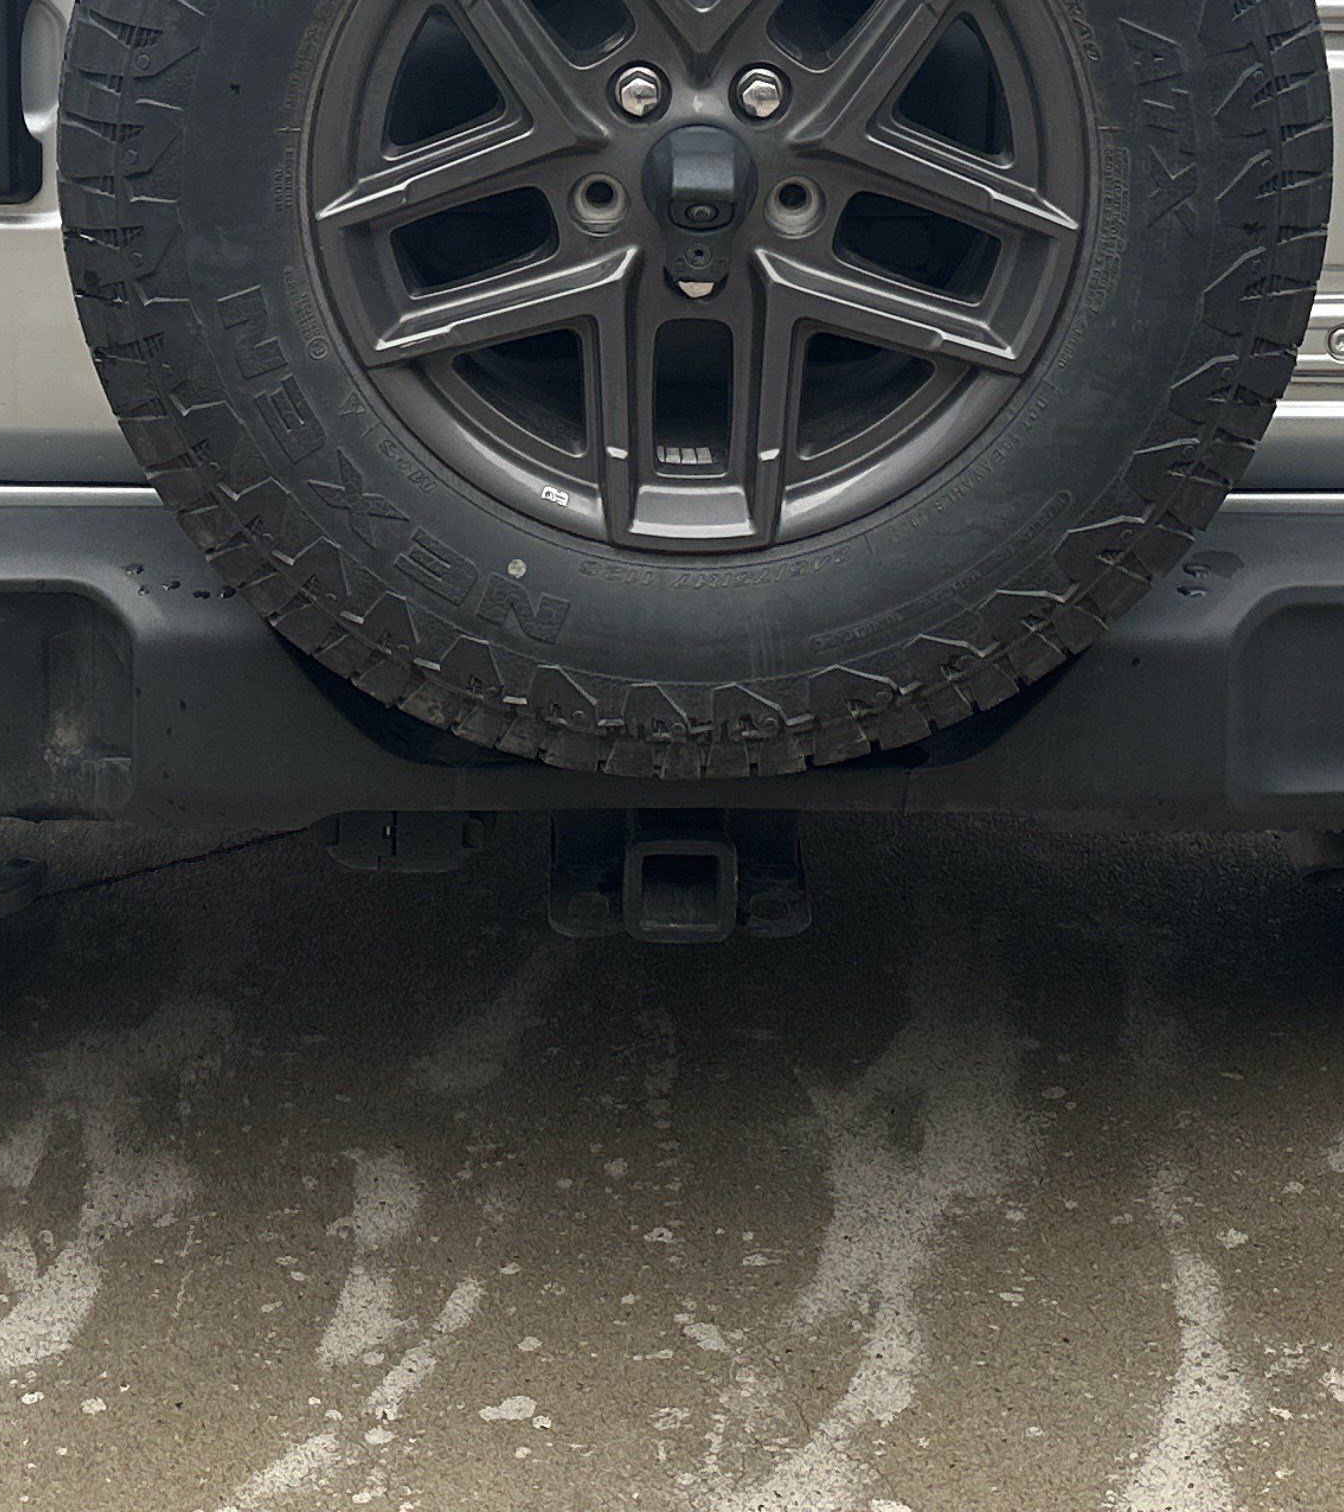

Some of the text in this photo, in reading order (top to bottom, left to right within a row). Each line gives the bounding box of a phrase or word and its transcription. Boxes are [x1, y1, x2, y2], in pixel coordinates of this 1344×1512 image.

[1116, 15, 1197, 236] ATX
[216, 284, 570, 645] NEXEN
[375, 437, 438, 496] M+S
[669, 548, 853, 589] 245/75R17
